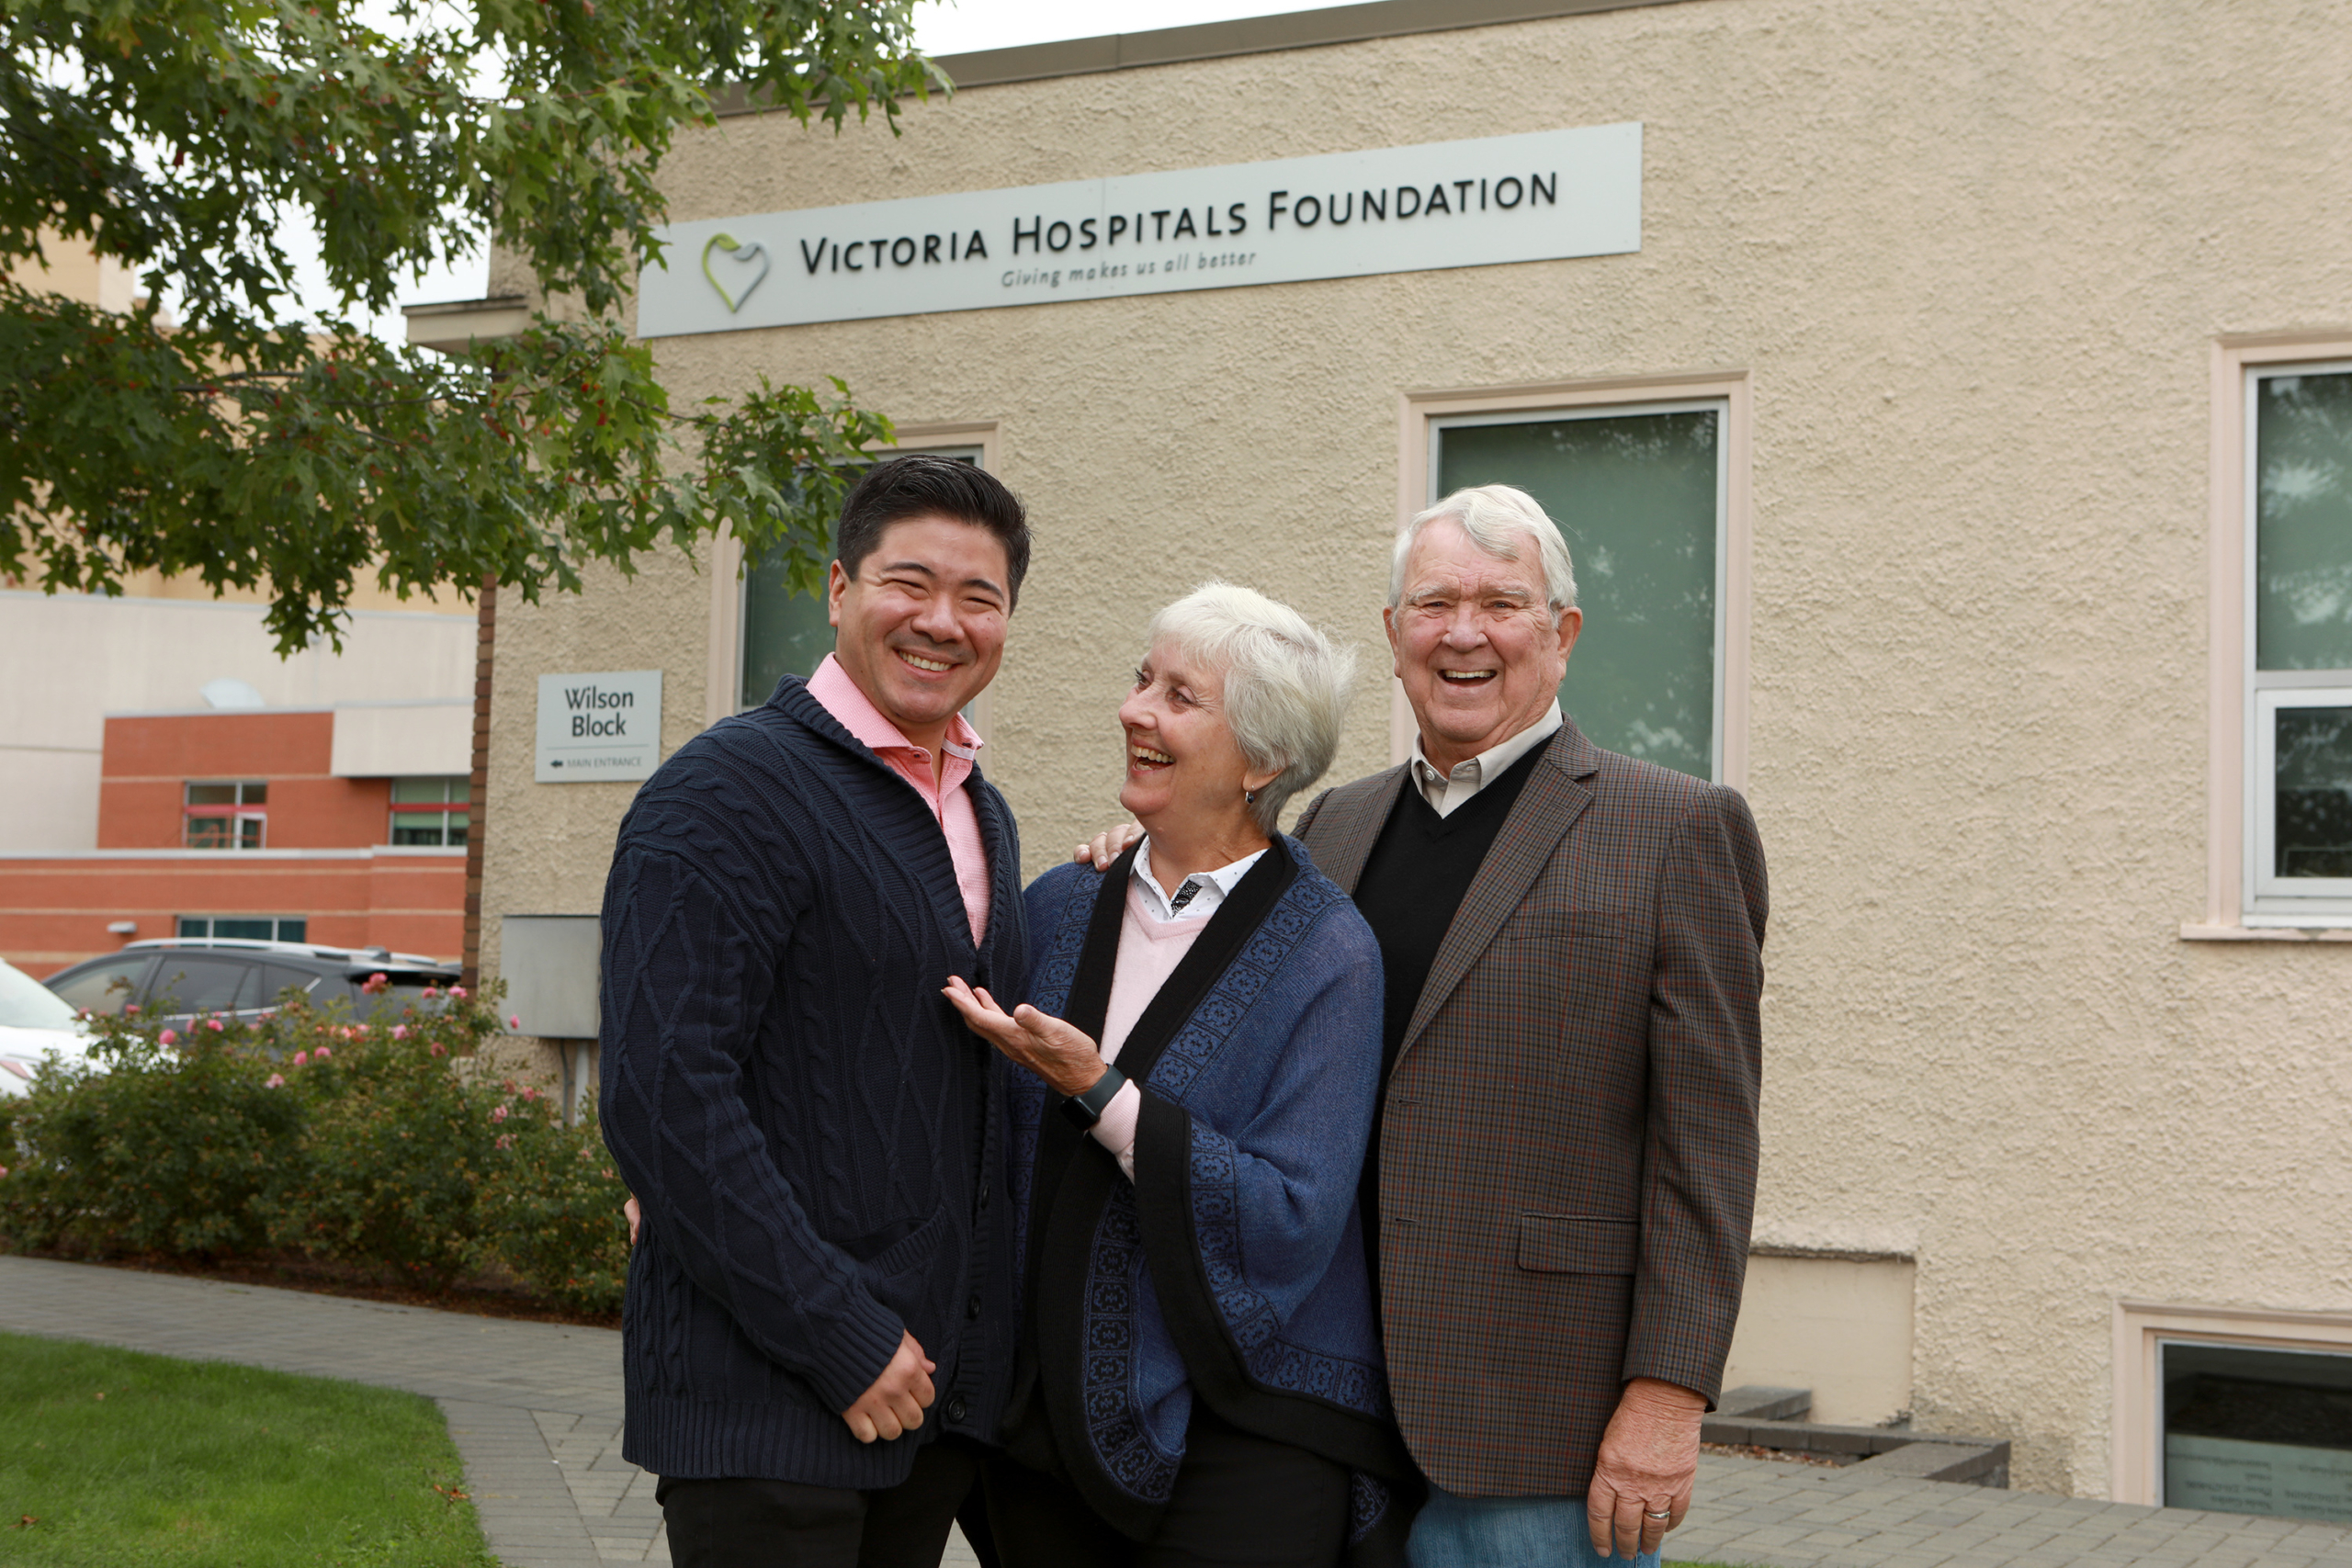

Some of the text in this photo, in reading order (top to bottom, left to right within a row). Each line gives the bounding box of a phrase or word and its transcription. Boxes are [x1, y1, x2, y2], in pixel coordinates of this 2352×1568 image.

[800, 172, 1556, 275] VICTORIA HOSPITALS FOUNDATION
[1001, 252, 1257, 288] Giving makes us all better
[565, 685, 634, 710] Wilson
[571, 712, 627, 738] Block
[567, 756, 642, 768] MAIN ENTRANCE
